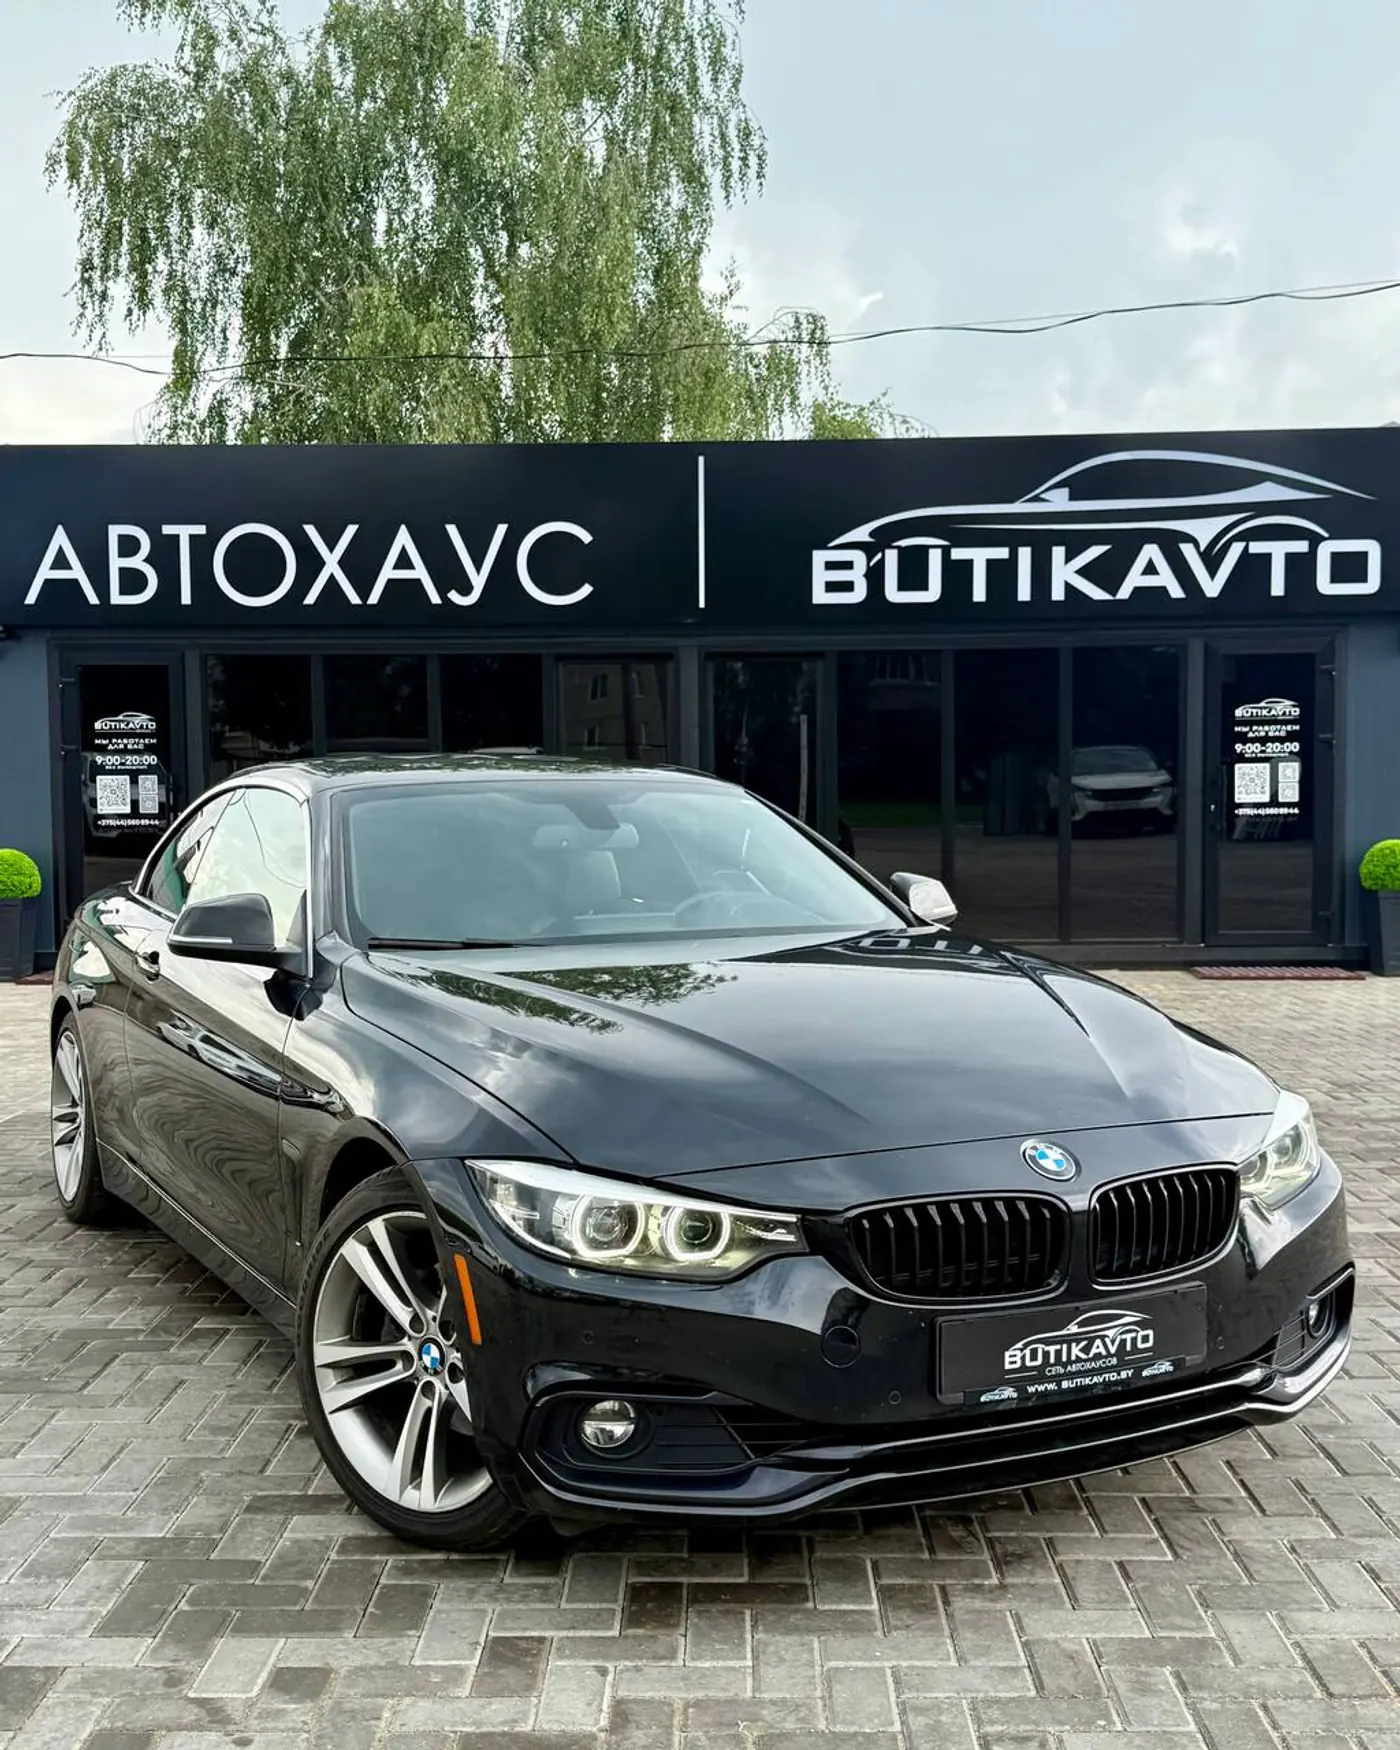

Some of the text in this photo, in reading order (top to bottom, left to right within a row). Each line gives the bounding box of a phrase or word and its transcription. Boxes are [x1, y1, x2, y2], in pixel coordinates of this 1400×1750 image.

[23, 520, 595, 608] АВТОХАУС
[811, 537, 1383, 606] BUTIKAVTO
[1234, 707, 1300, 717] BUTIKAVTO
[94, 720, 157, 730] BUTIKAVTO
[1234, 742, 1300, 754] 9:00-20:00
[95, 755, 158, 766] 9:00-20:00
[1004, 1329, 1154, 1370] BUTIKAVTO
[1045, 1357, 1118, 1377] СЕТЬ АВТОХАУСОВ
[1026, 1369, 1134, 1394] WWW. BUTIKAVTO.BY
